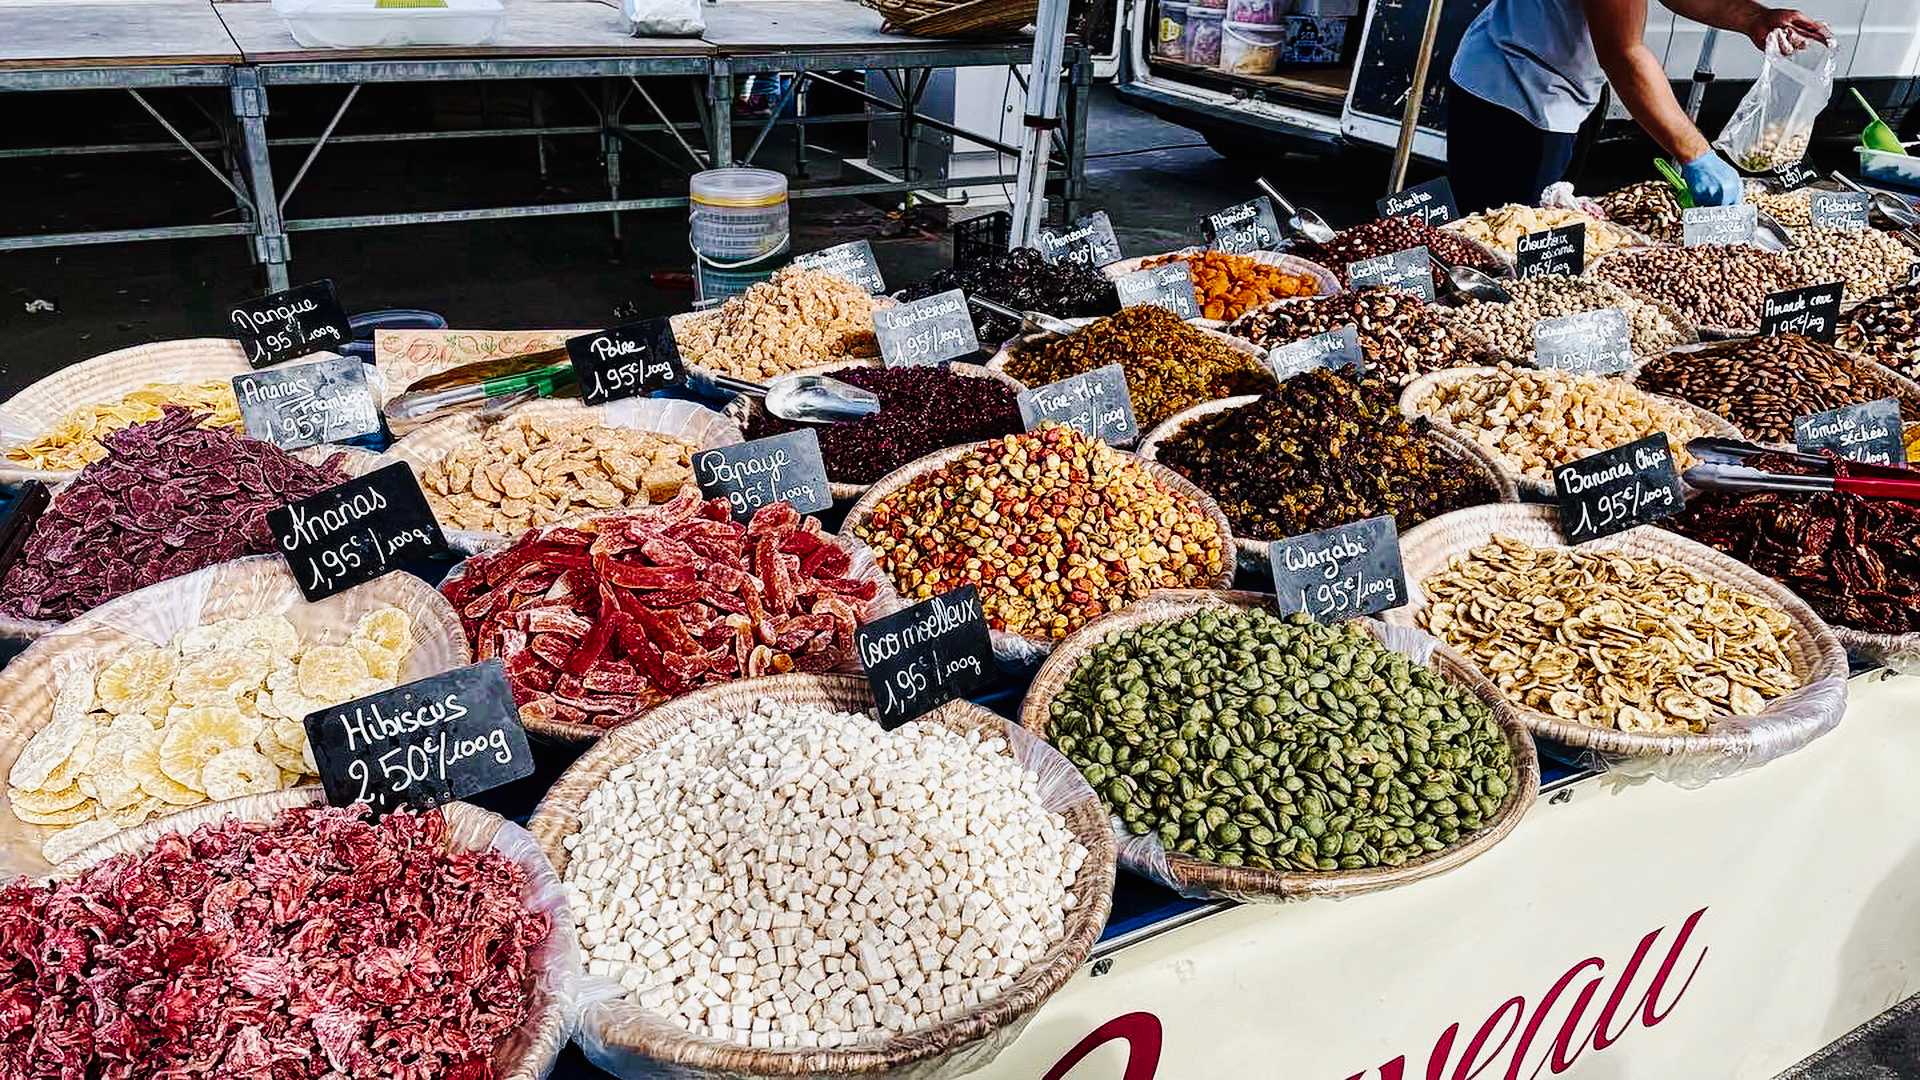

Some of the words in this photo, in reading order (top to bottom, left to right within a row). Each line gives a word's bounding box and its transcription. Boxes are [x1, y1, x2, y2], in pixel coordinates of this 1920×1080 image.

[1210, 204, 1257, 231] Abricots
[1042, 225, 1096, 251] Pruneaux
[886, 298, 961, 330] Cranberries
[590, 337, 646, 361] Poire
[241, 377, 315, 406] Ananas
[1798, 414, 1857, 441] Tomates
[701, 448, 791, 489] Papaye
[1558, 462, 1635, 494] Bananes
[1285, 532, 1368, 580] Wazabi
[860, 632, 901, 669] Coco
[339, 693, 469, 751] Hibiscus
